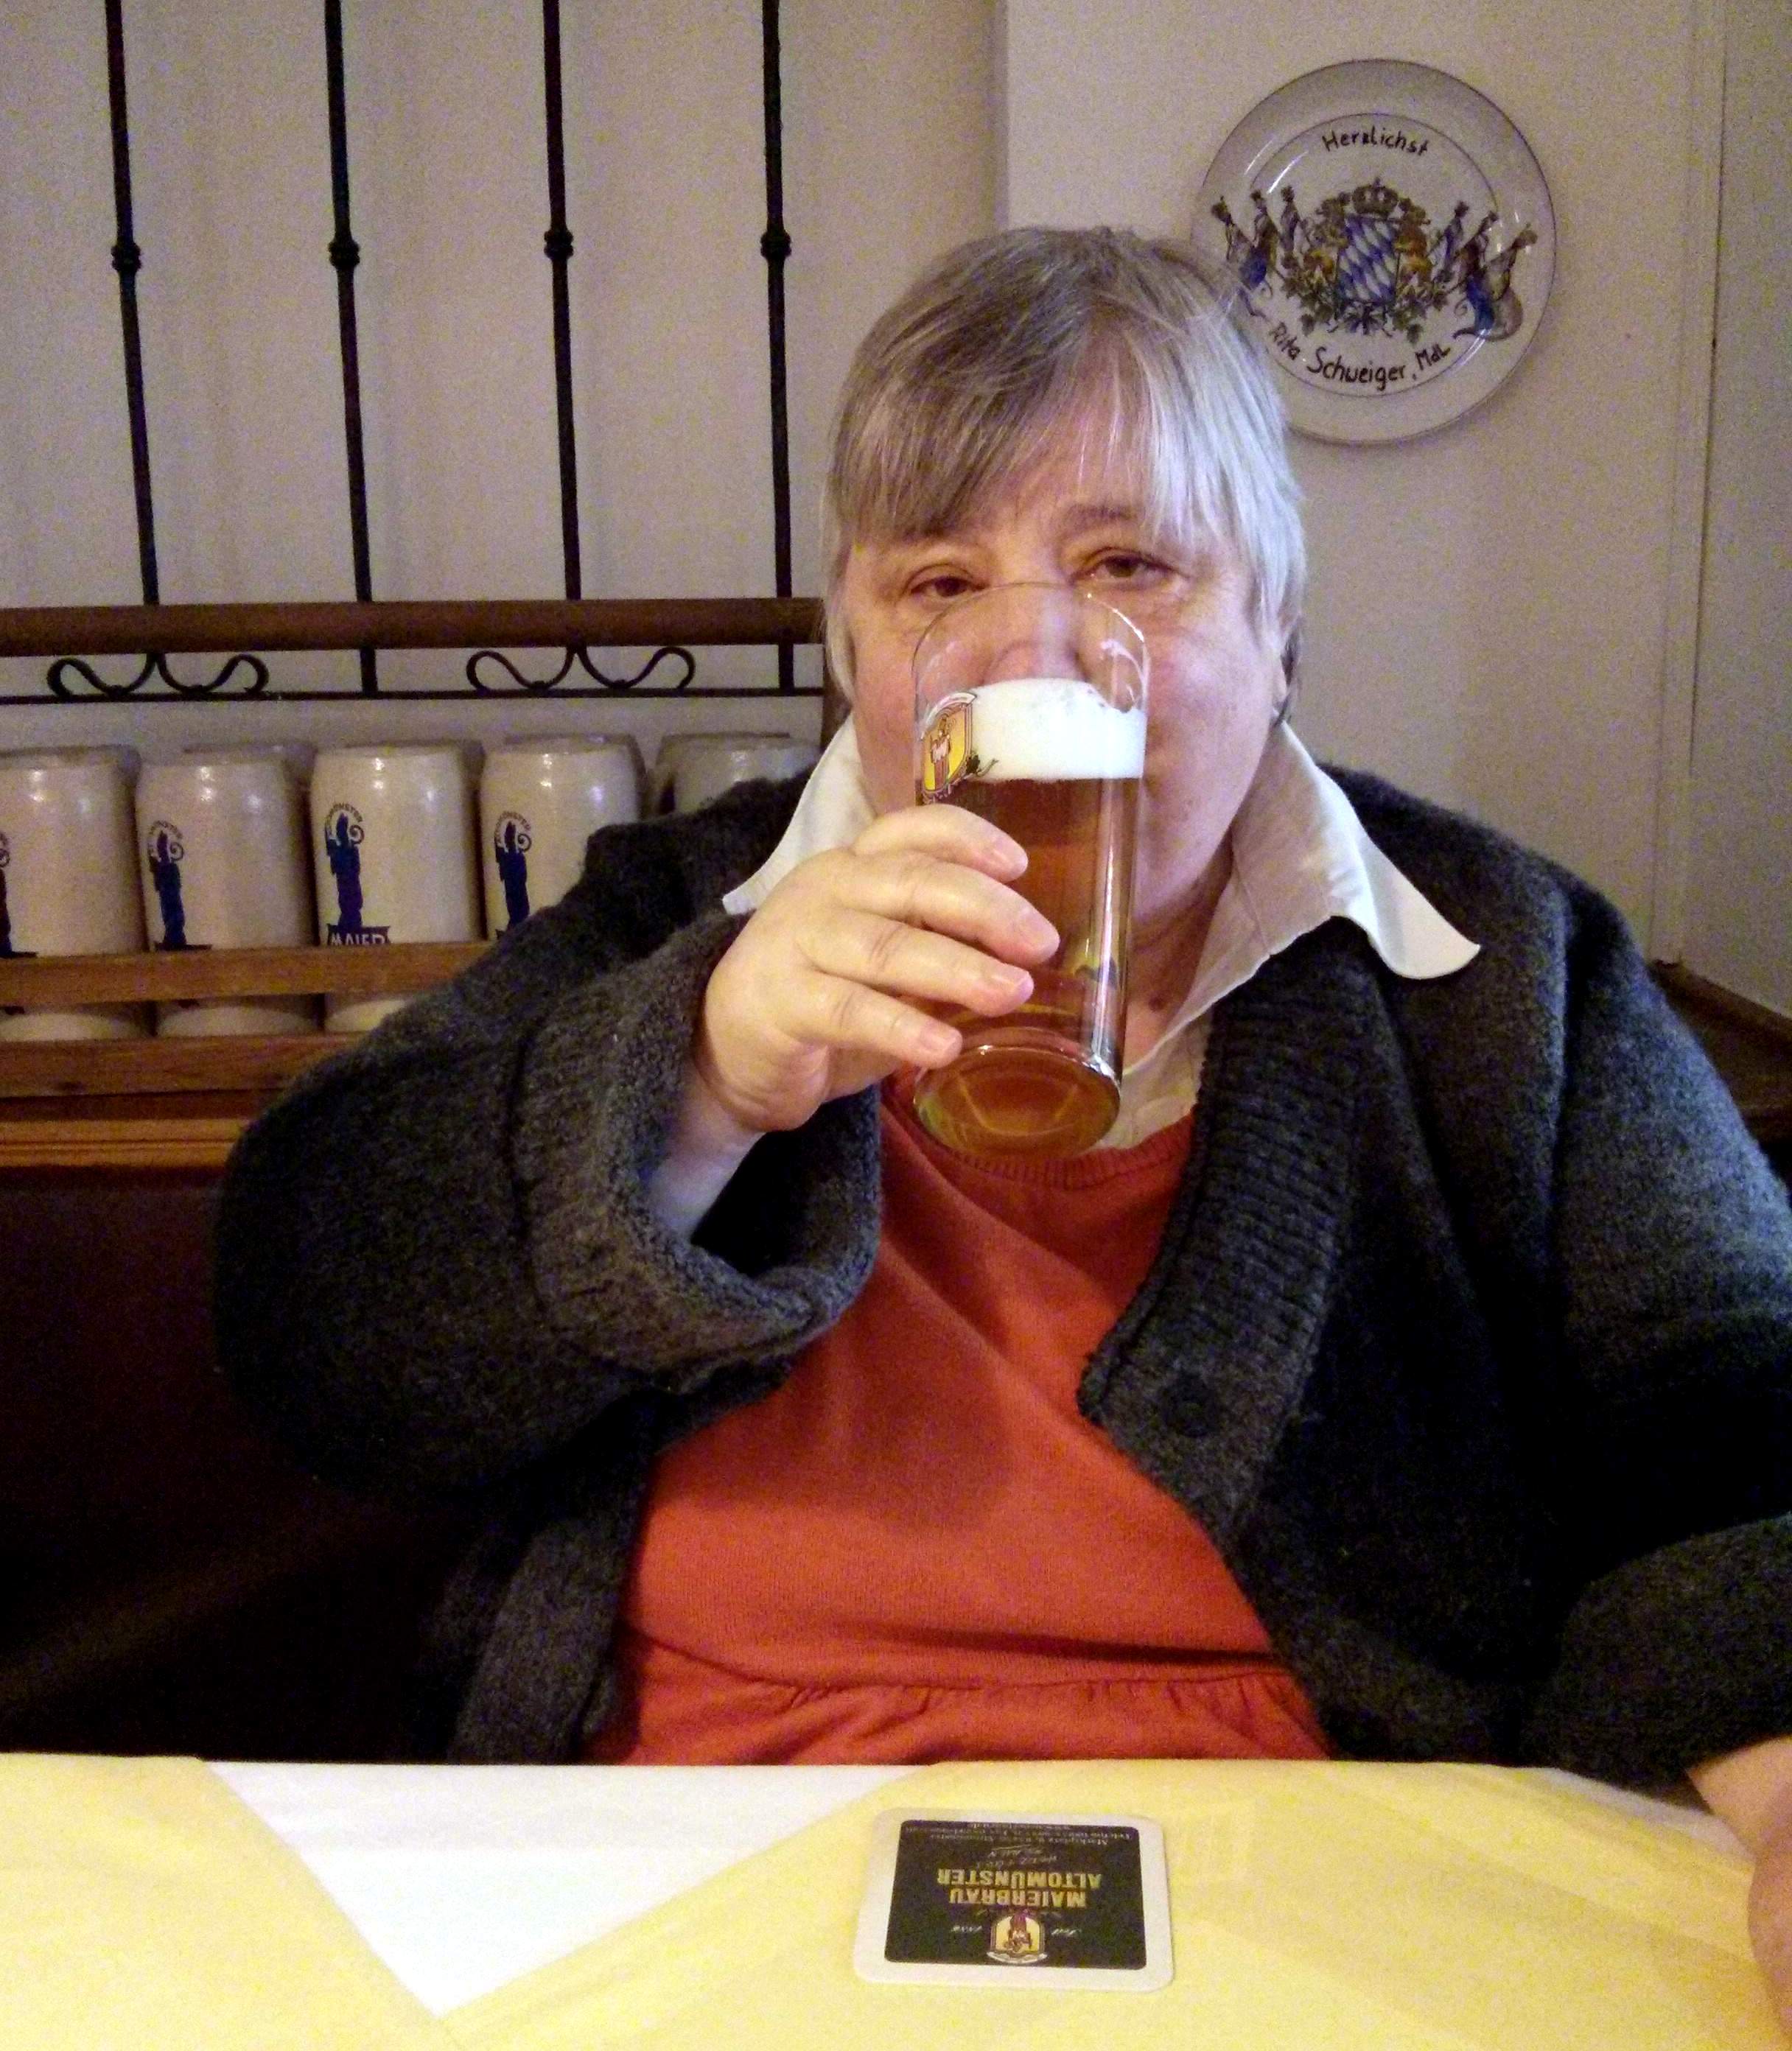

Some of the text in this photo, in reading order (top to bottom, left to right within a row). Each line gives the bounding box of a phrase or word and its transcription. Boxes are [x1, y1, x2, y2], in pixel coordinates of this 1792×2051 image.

[1322, 125, 1429, 156] Herzlichst
[1270, 322, 1301, 360] Rita
[1415, 343, 1451, 371] MdL
